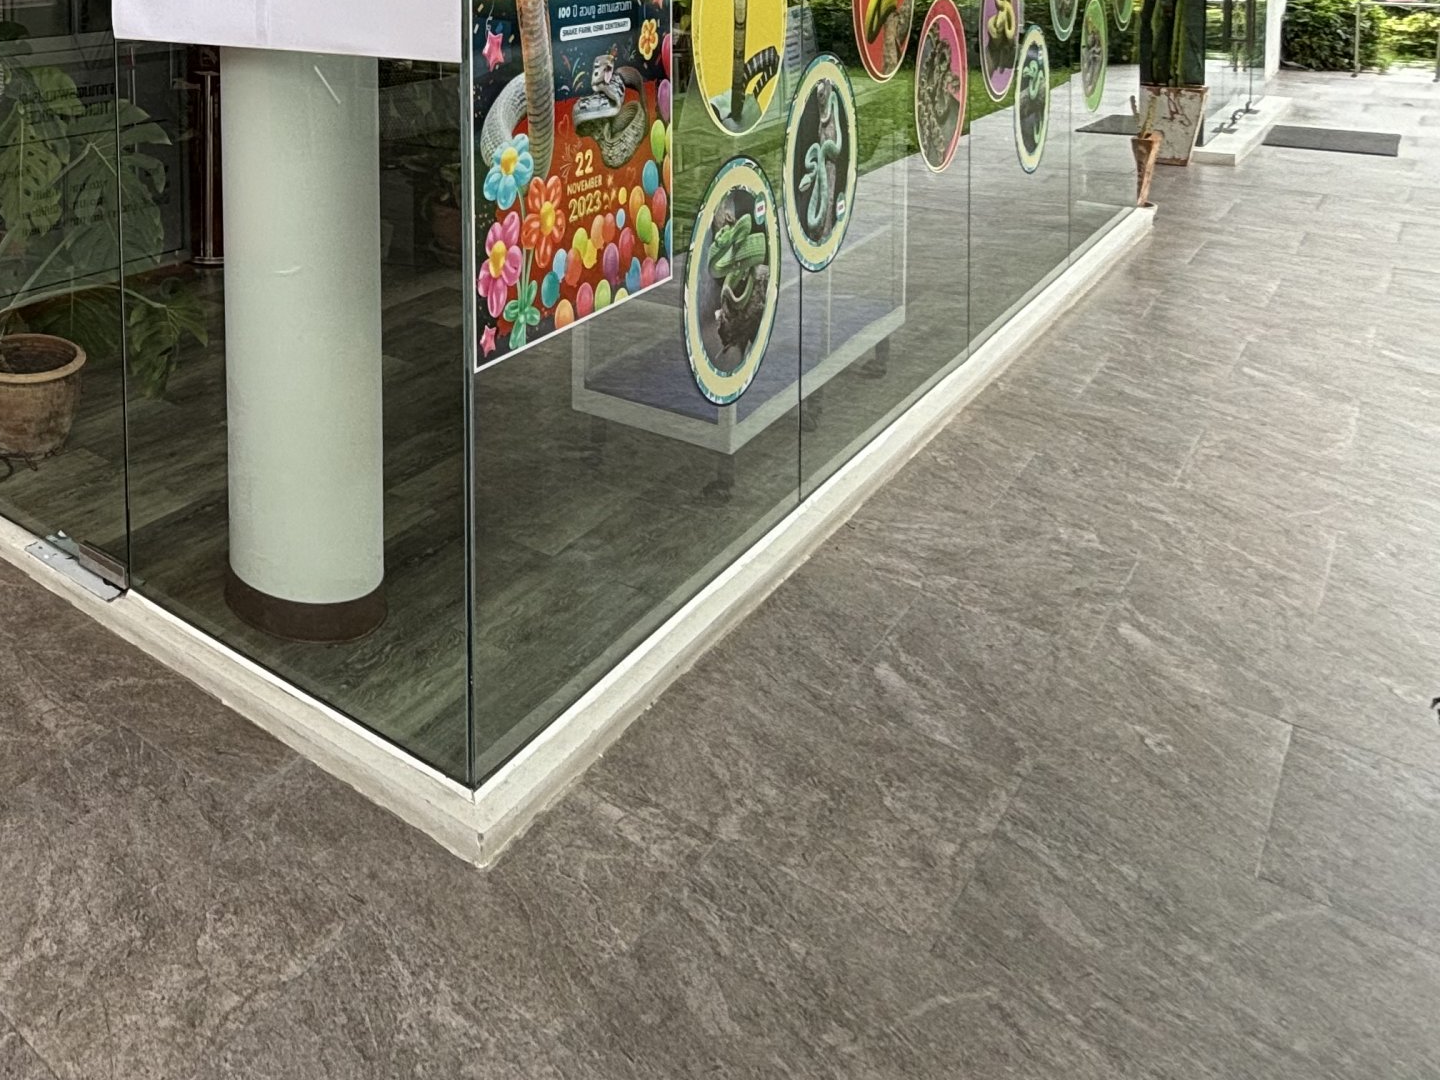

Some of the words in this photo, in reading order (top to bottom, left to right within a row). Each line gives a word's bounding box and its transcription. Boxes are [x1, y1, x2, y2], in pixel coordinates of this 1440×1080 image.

[558, 6, 571, 19] 100
[562, 27, 578, 37] SNAKE
[575, 148, 594, 177] 22
[567, 174, 603, 197] NOVEMBER
[568, 189, 602, 224] 2023
